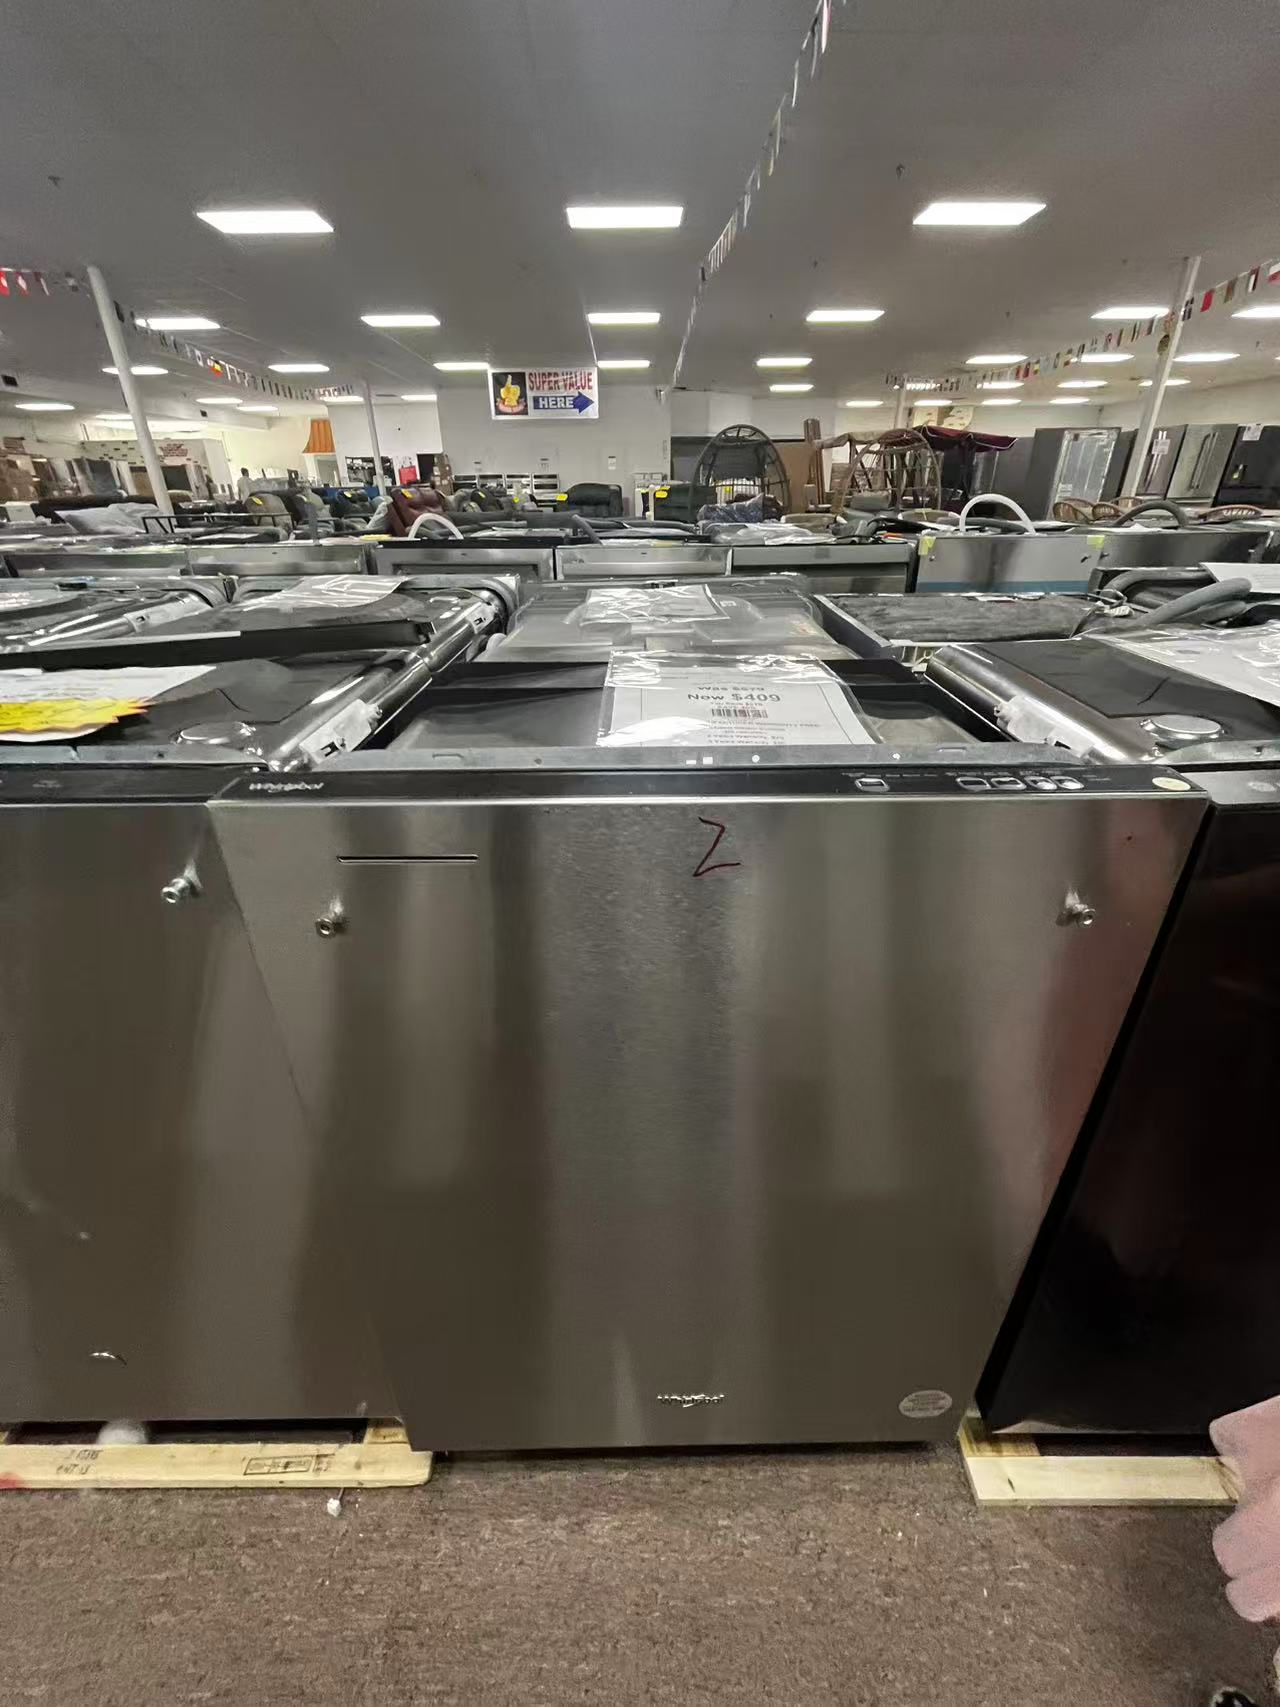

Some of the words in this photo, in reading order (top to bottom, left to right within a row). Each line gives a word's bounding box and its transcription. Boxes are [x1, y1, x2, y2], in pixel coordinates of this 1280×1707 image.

[528, 371, 560, 391] SUPER
[561, 370, 593, 391] VALUE
[539, 397, 574, 409] HERE
[732, 693, 781, 702] $409
